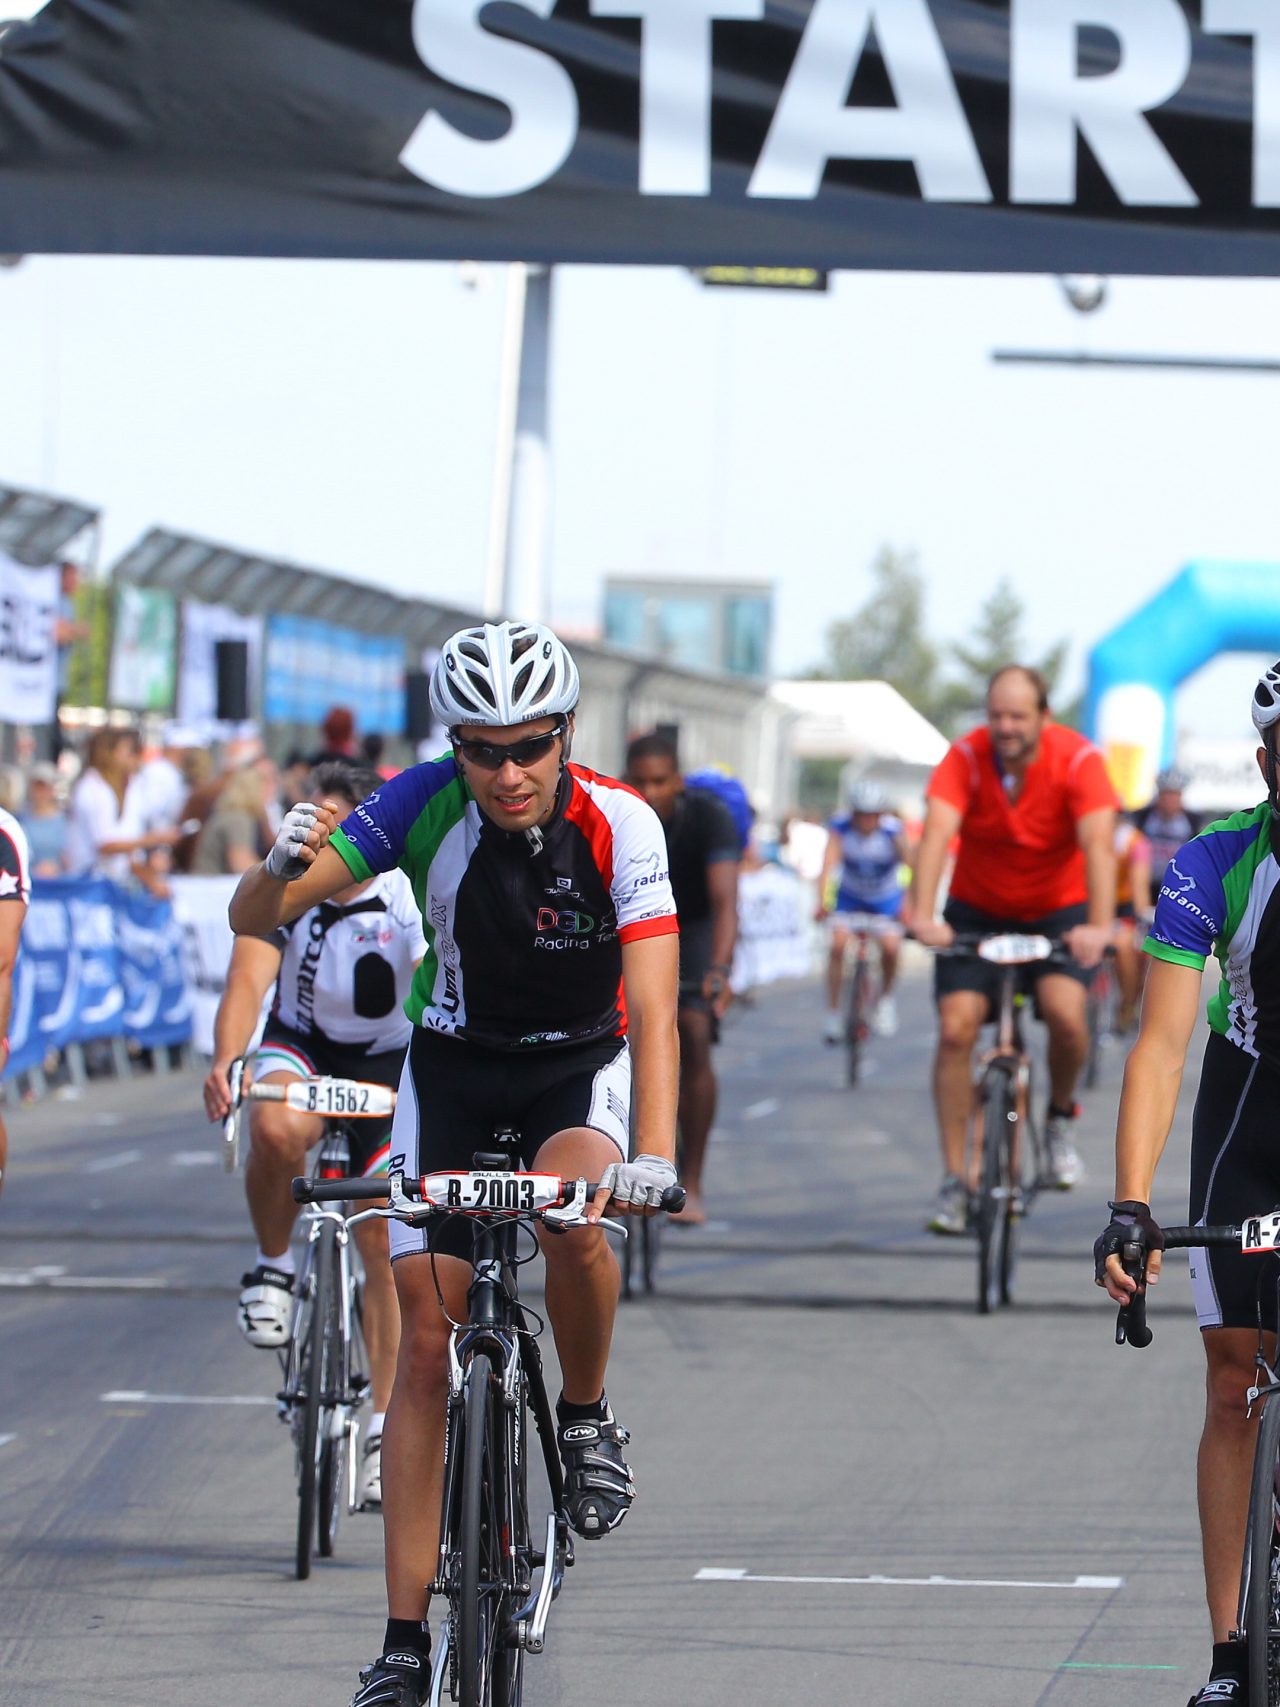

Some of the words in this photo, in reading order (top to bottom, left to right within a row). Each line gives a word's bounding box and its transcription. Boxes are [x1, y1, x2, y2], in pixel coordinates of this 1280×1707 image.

[522, 708, 548, 721] uvex
[461, 717, 487, 726] uvex
[537, 907, 595, 934] DGD
[534, 936, 590, 950] Racing
[308, 1085, 370, 1113] B-1562
[448, 1179, 535, 1209] B-2003
[568, 1428, 593, 1438] NW
[390, 1655, 416, 1663] NW
[1203, 1683, 1234, 1695] SIDI
